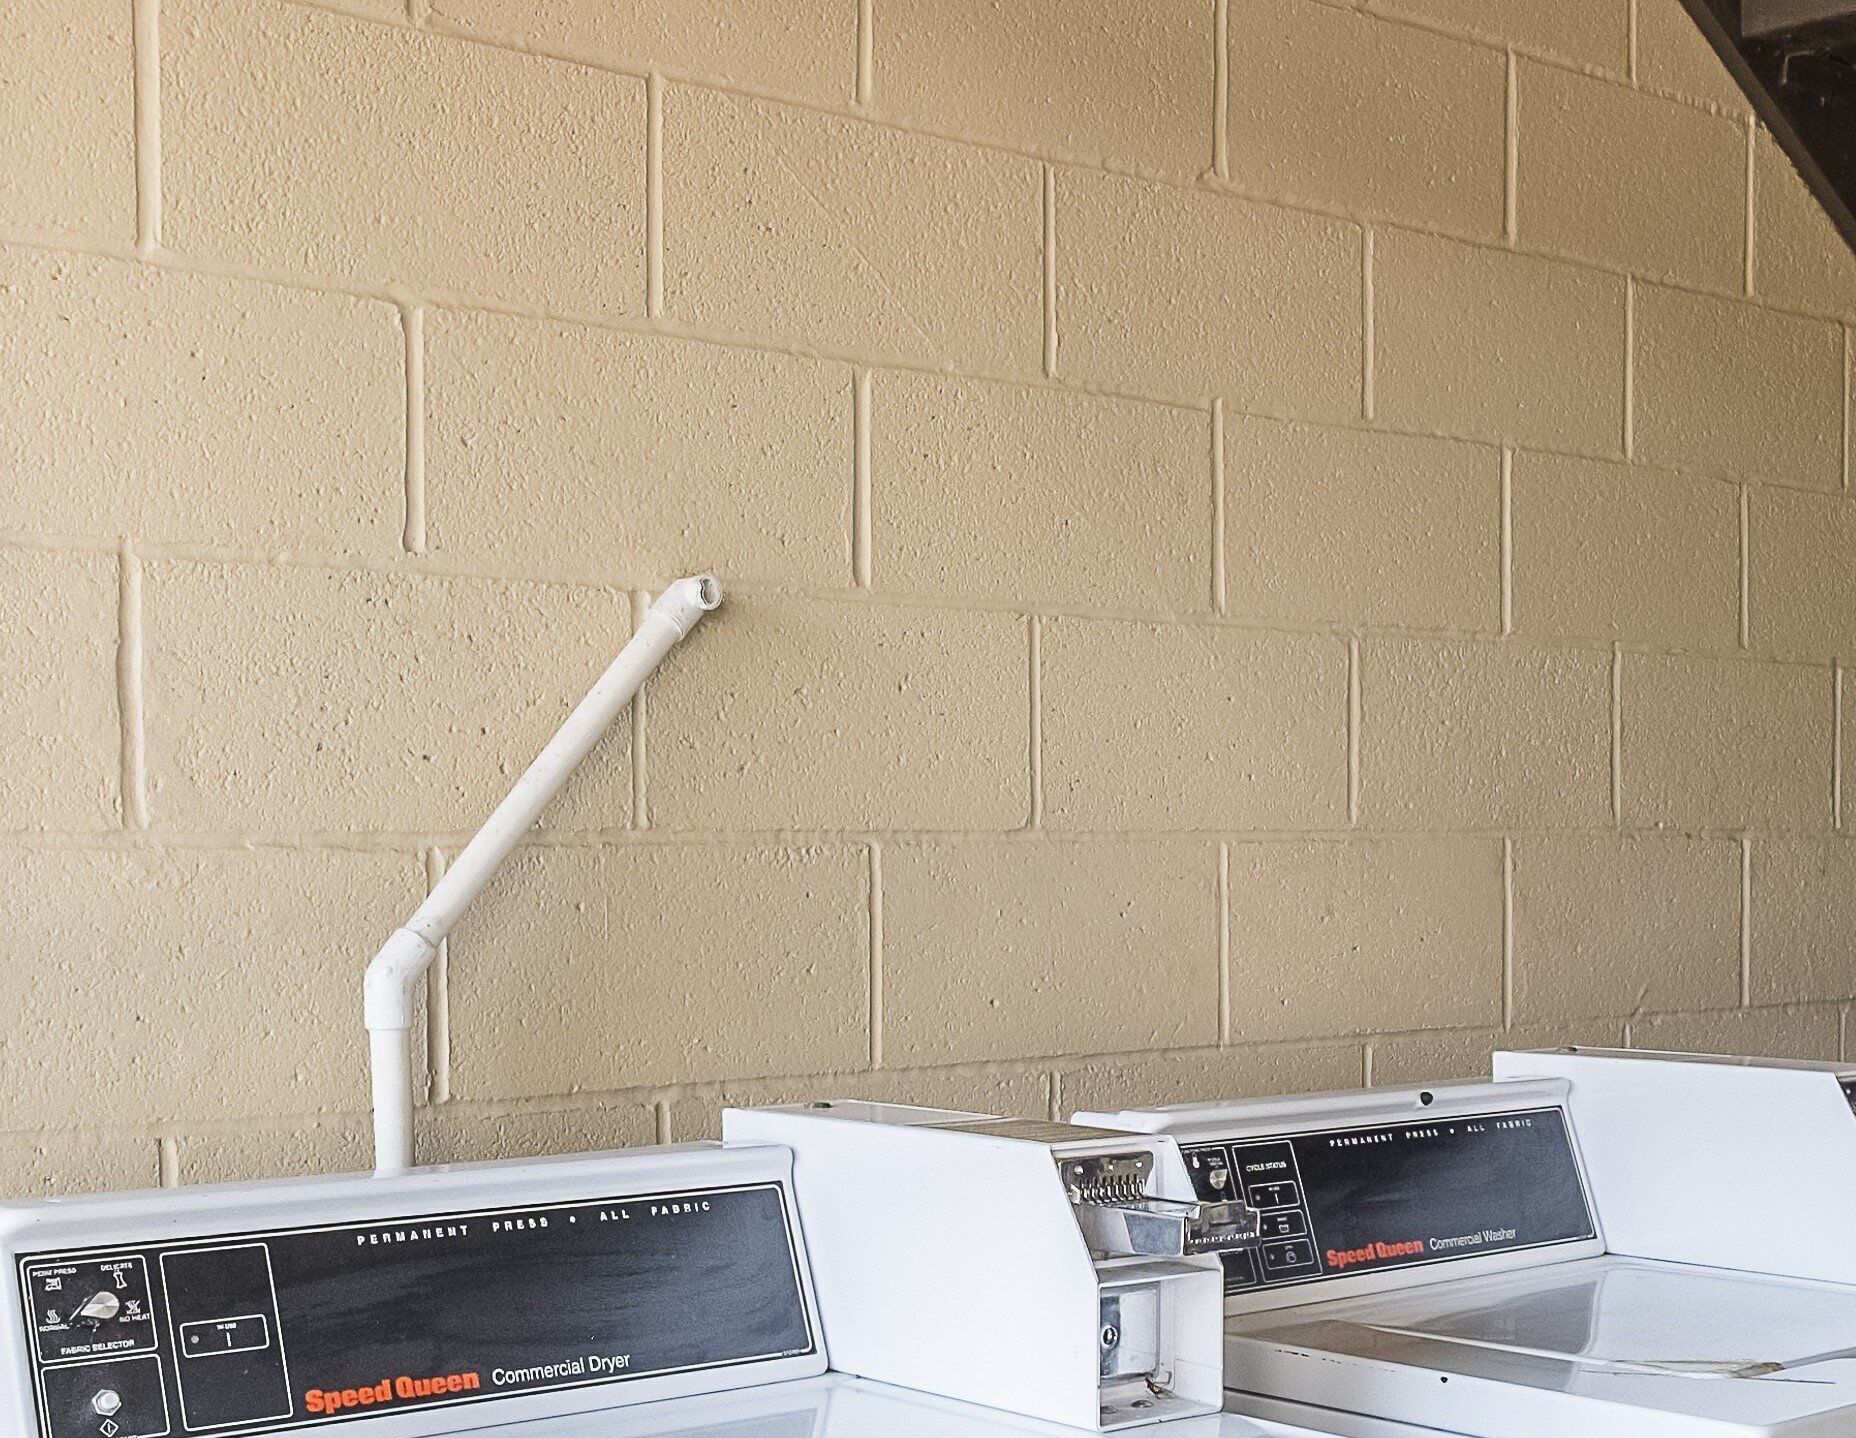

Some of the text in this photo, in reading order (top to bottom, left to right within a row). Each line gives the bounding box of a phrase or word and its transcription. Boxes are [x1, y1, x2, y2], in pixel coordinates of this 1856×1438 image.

[1329, 1133, 1394, 1147] PERMANENT
[1467, 1124, 1485, 1132] ALL
[357, 1201, 711, 1246] PERMANENT PRESS ALL FABRIC
[1326, 1227, 1517, 1268] Speed Queen Commercial Washer
[305, 1353, 632, 1414] Speed Queen Commercial Dryer
